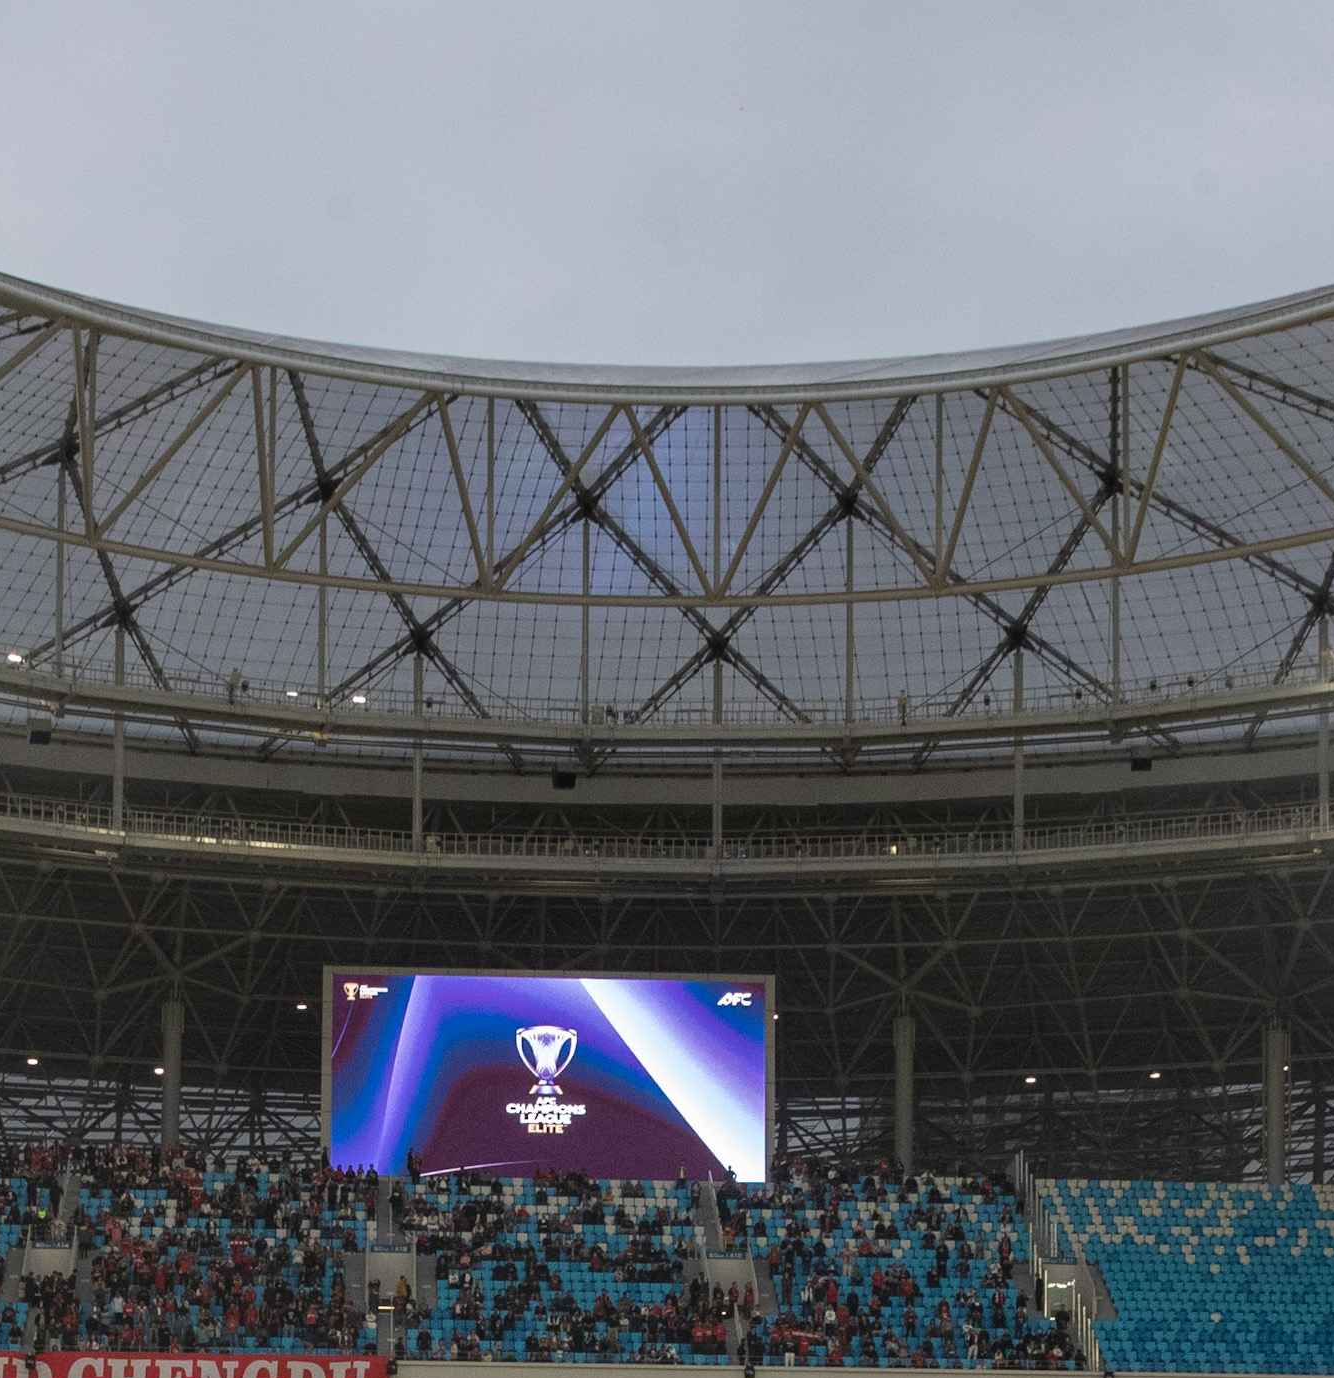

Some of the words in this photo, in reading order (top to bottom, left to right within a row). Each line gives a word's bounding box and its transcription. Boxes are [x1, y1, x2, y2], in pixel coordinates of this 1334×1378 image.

[717, 991, 752, 1007] AFC
[506, 1103, 587, 1116] CHAMPIONS
[520, 1114, 572, 1125] LEAGUE
[528, 1124, 564, 1134] ELITE
